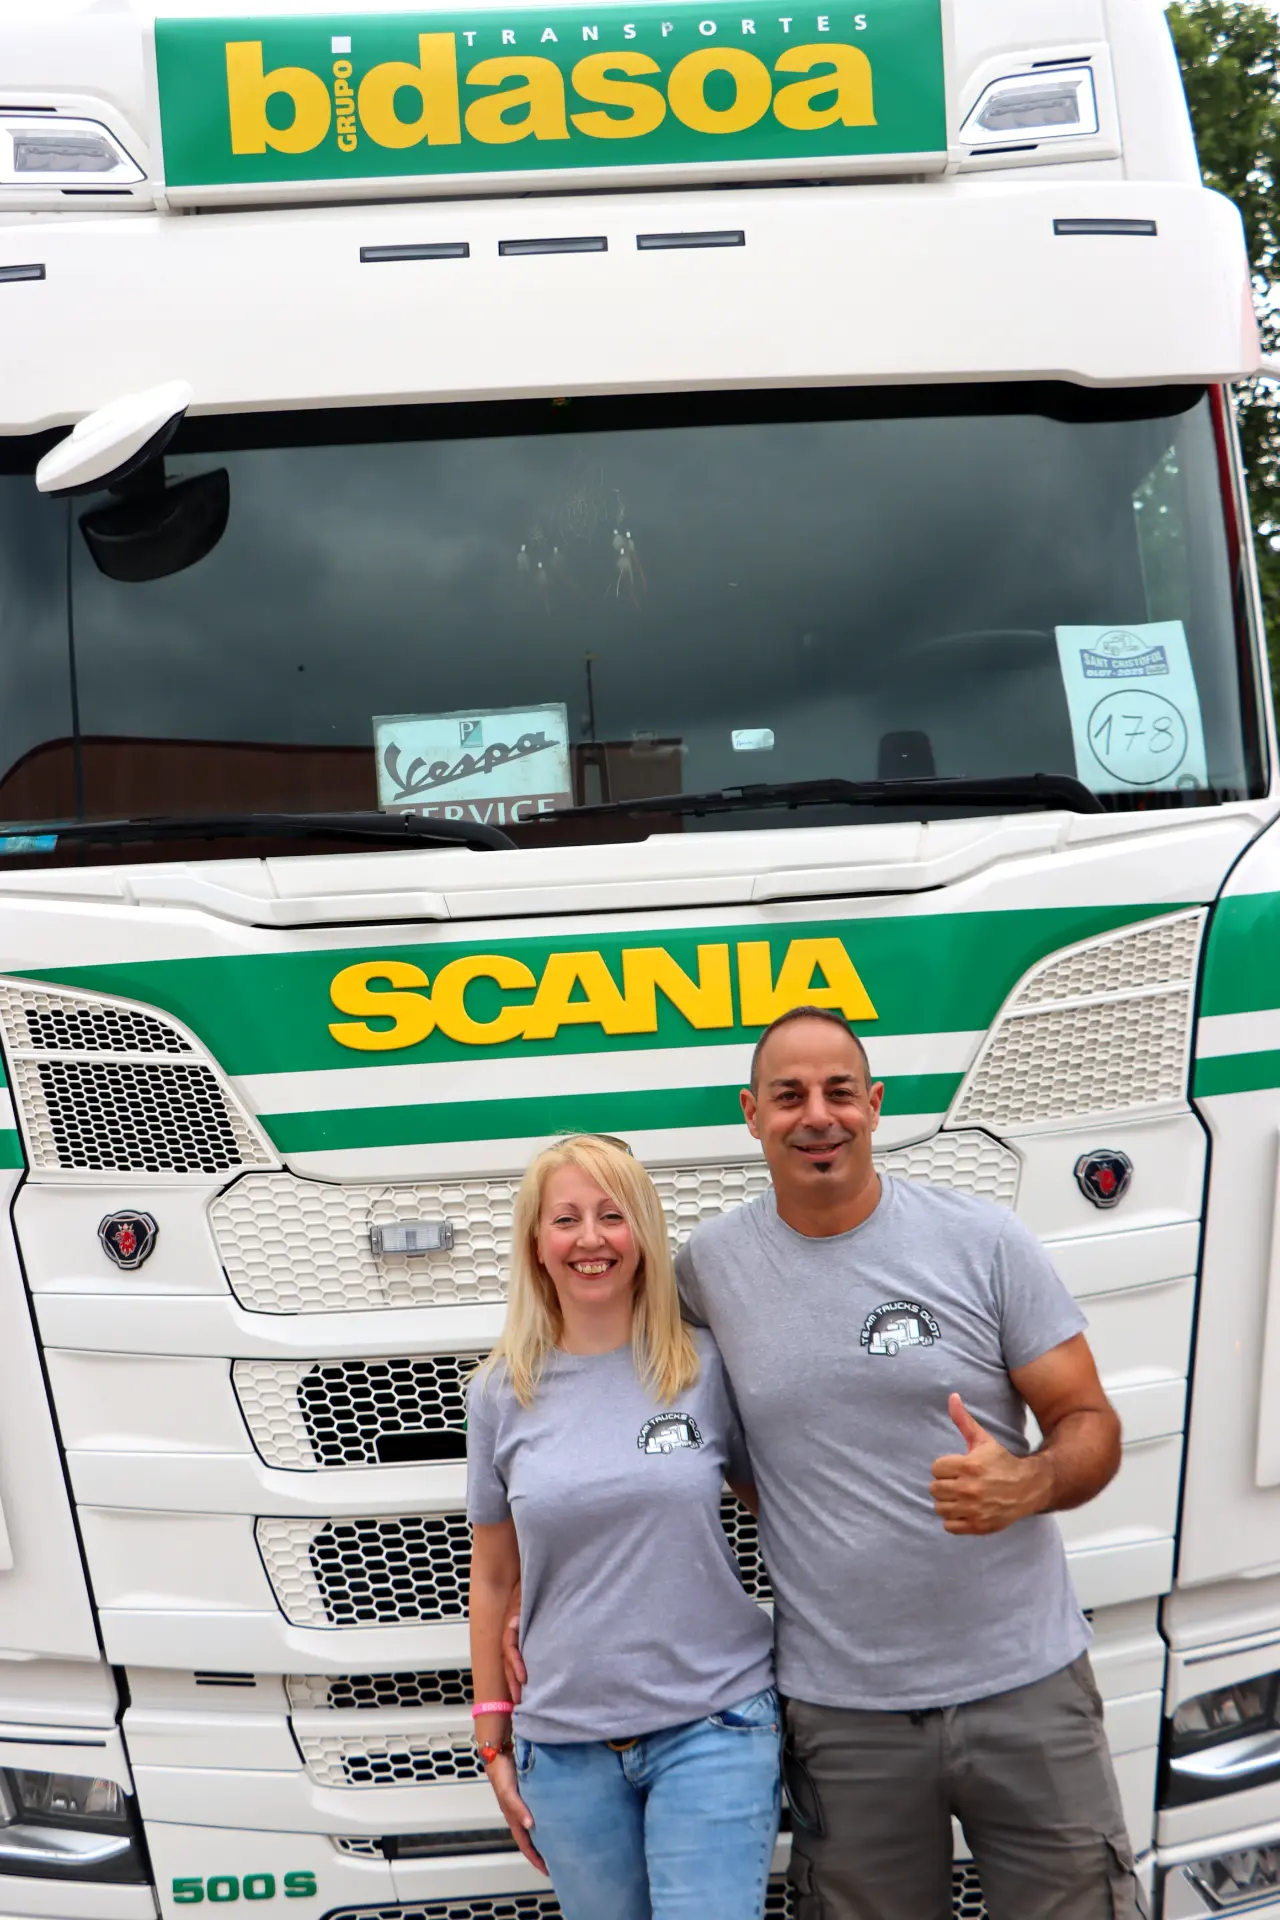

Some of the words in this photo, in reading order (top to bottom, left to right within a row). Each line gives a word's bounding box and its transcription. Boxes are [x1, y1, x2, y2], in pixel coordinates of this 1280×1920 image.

[463, 14, 868, 47] TRANSPORTES
[332, 60, 358, 152] GRUPO
[1083, 652, 1109, 668] SANT
[1094, 713, 1175, 756] 178
[384, 731, 560, 801] Vespa
[328, 937, 879, 1052] SCANIA
[861, 1314, 877, 1345] TEAM
[875, 1302, 920, 1316] TRUCKS
[920, 1310, 940, 1338] OLOT
[649, 1413, 688, 1425] TRUCKS
[688, 1418, 704, 1444] OLOT
[172, 1873, 276, 1904] 500
[284, 1870, 317, 1898] S
